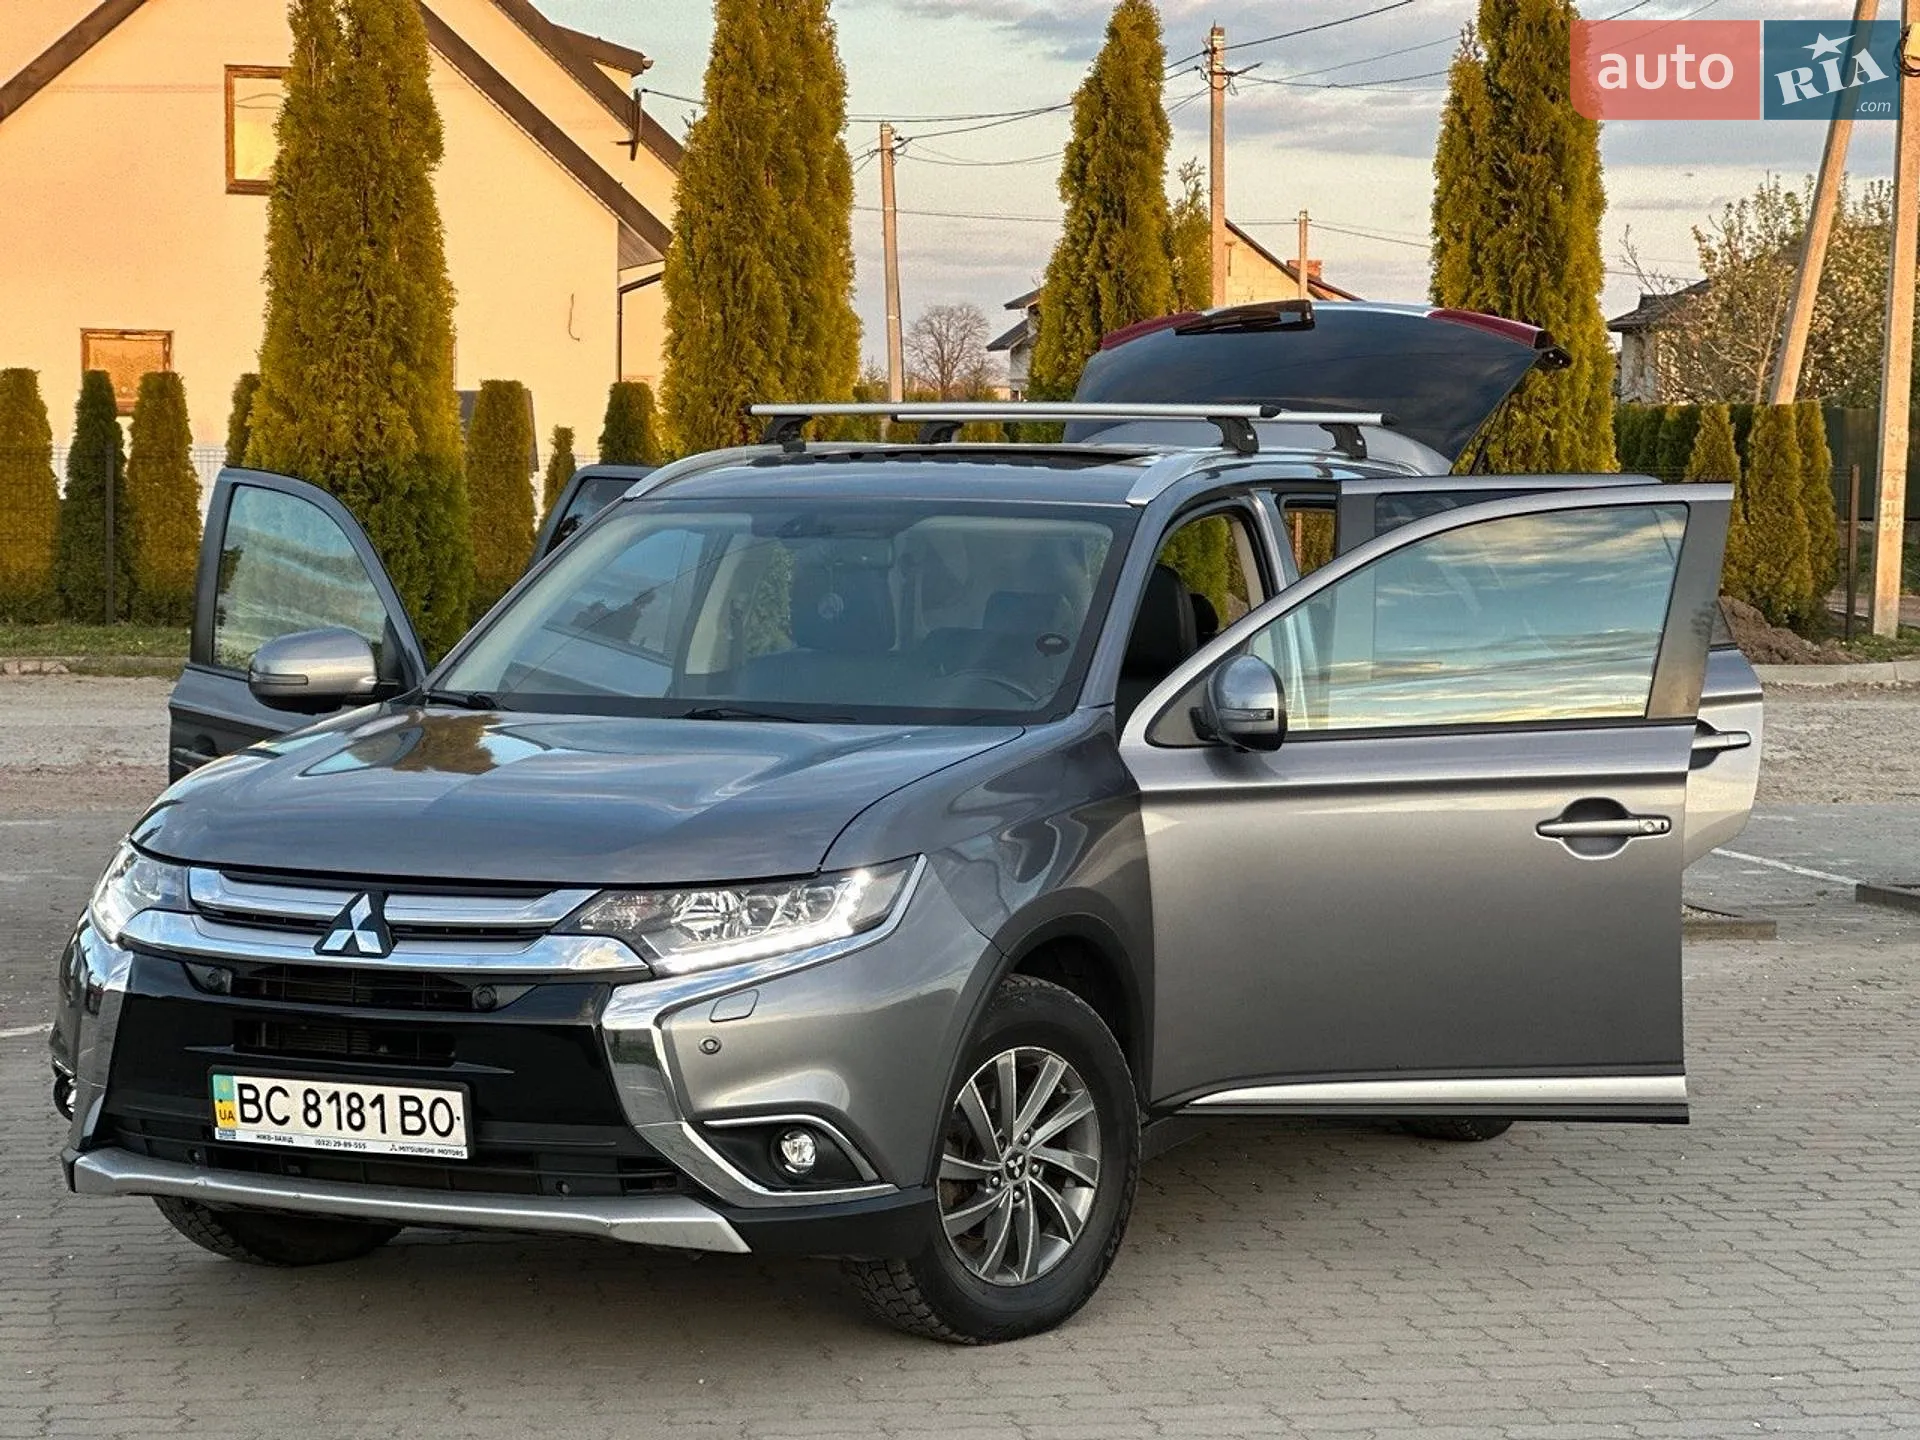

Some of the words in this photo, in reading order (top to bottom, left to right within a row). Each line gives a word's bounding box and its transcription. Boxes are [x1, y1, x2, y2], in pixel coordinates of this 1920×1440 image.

[218, 1108, 236, 1121] UA
[237, 1083, 291, 1126] BC
[303, 1088, 387, 1134] 8181
